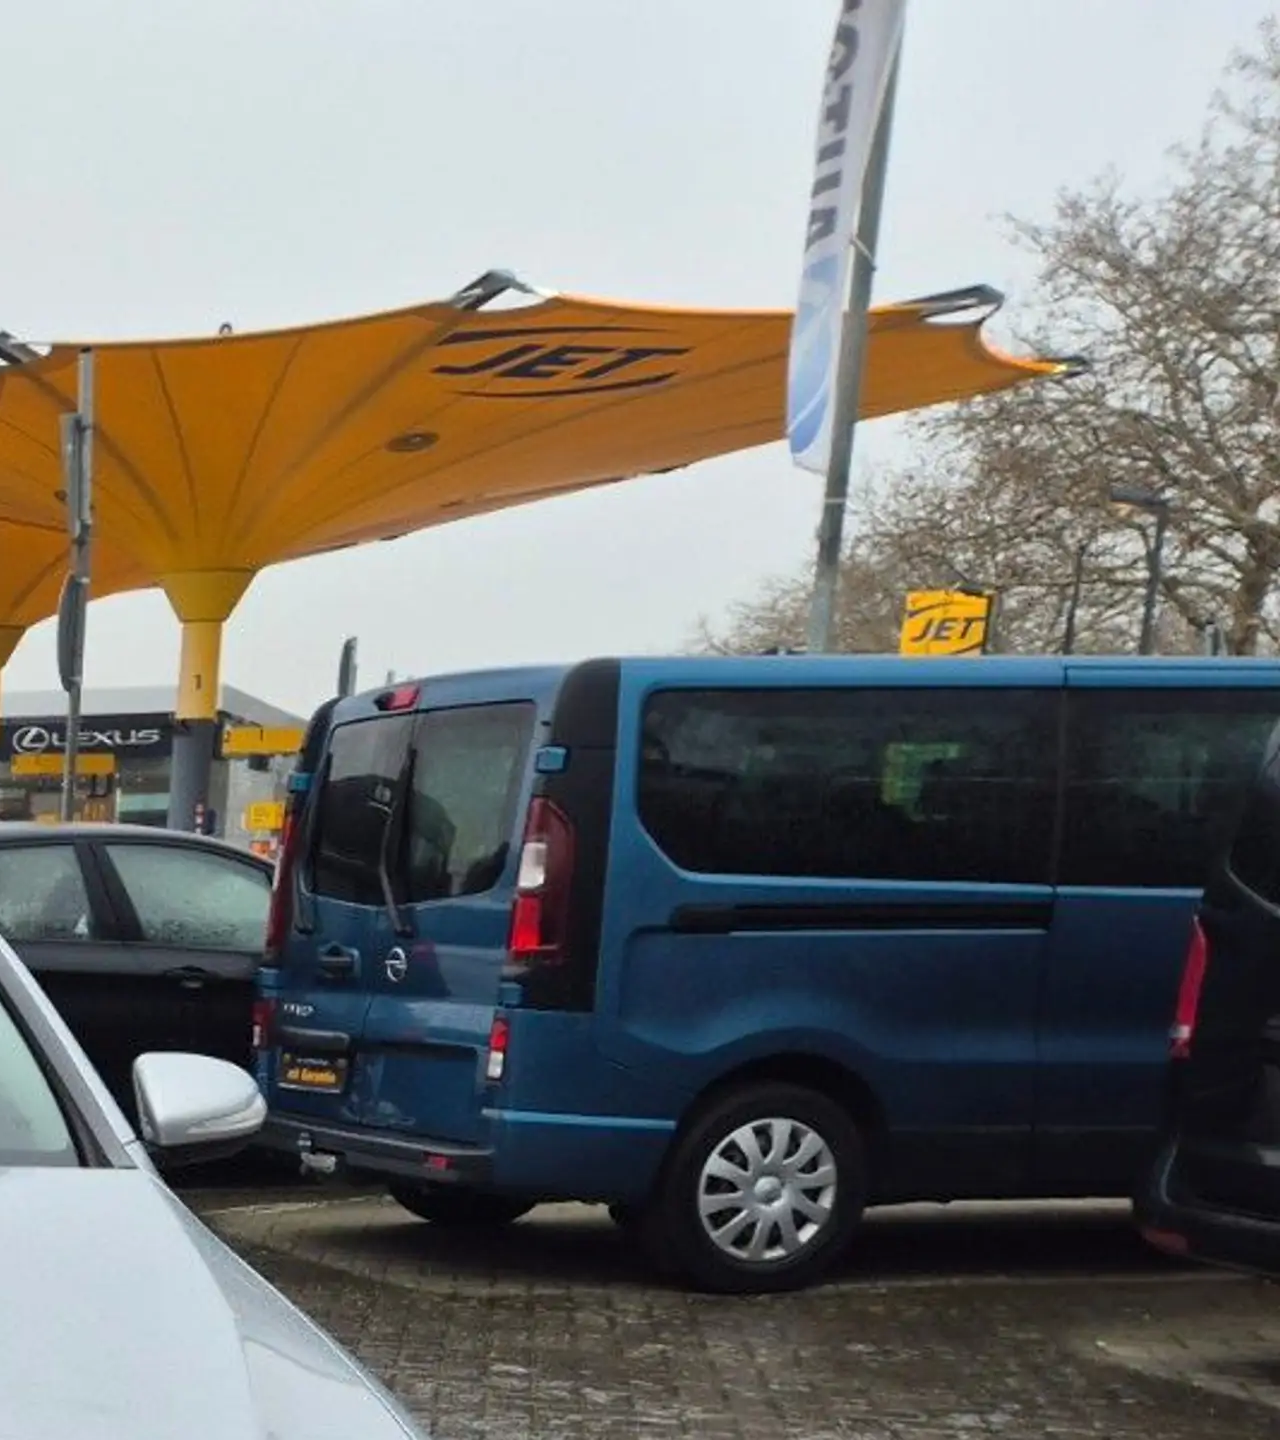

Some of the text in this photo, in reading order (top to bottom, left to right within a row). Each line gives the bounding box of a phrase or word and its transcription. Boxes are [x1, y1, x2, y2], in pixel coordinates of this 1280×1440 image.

[431, 343, 693, 379] JET
[909, 616, 987, 643] JET
[193, 674, 202, 690] 1
[51, 729, 161, 747] LEXUS
